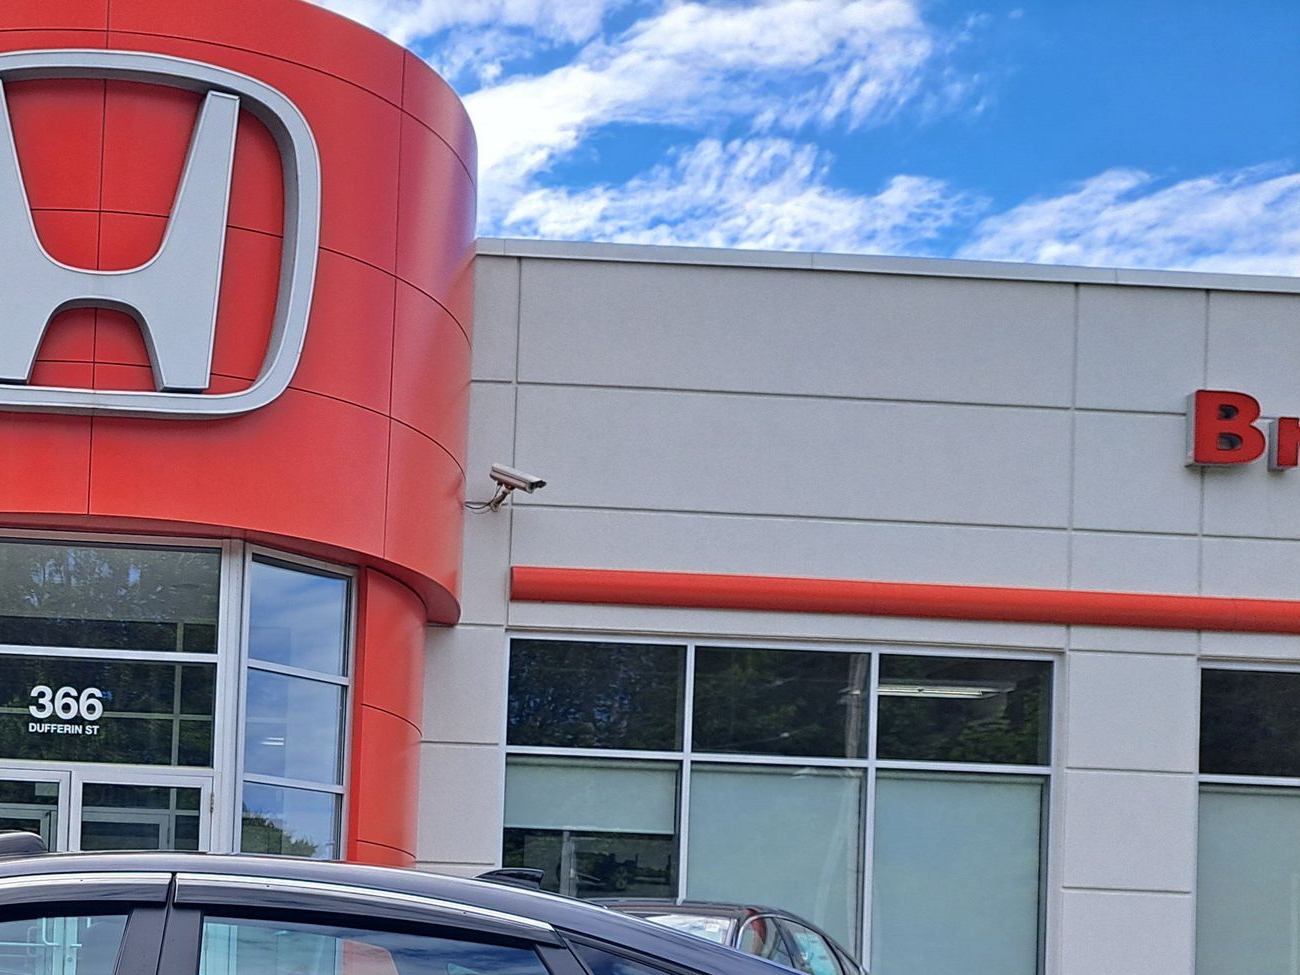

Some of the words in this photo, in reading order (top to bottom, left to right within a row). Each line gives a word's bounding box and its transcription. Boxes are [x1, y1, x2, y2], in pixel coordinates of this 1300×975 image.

[28, 685, 104, 721] 366
[28, 722, 83, 735] DUFFERIN
[85, 724, 100, 735] ST
